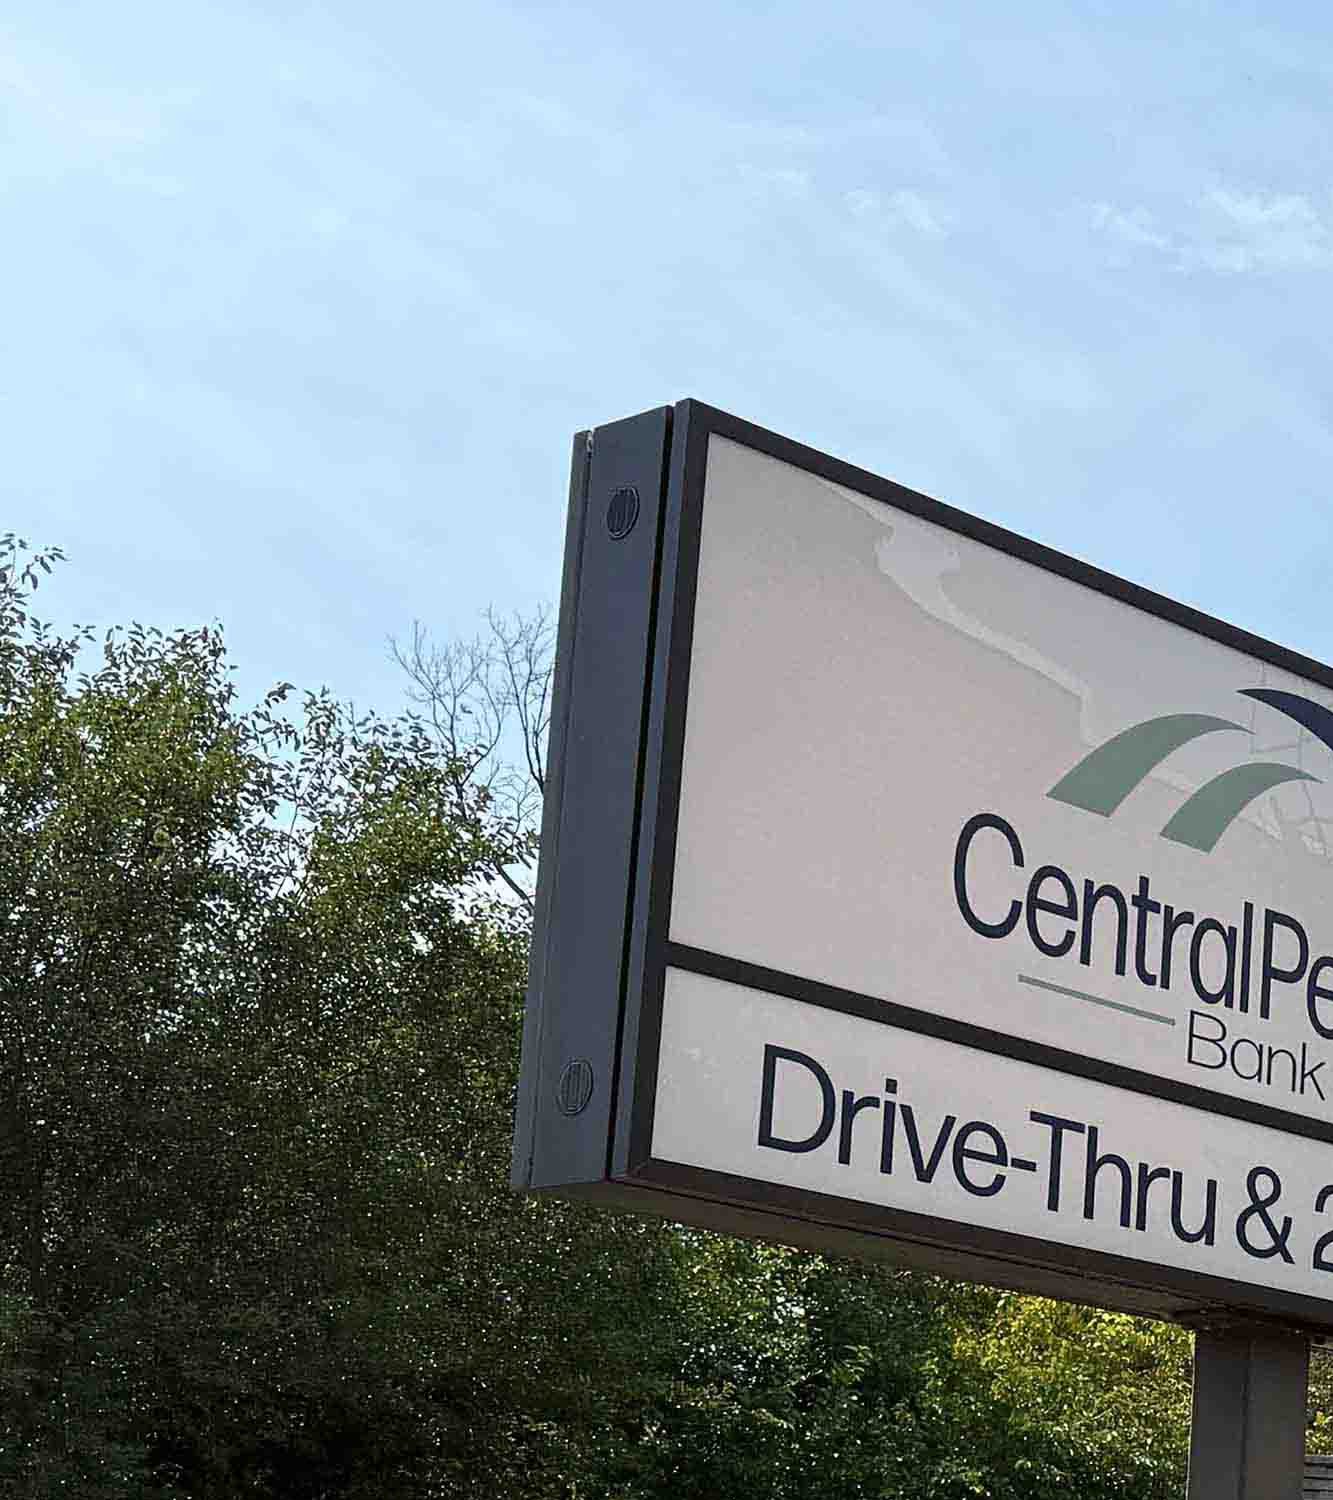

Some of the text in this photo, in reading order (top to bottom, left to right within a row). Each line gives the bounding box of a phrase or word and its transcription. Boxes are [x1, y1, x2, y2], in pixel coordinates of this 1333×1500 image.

[1186, 1009, 1326, 1102] Bank
[757, 1043, 1218, 1248] Drive-Thru
[1235, 1166, 1296, 1265] &
